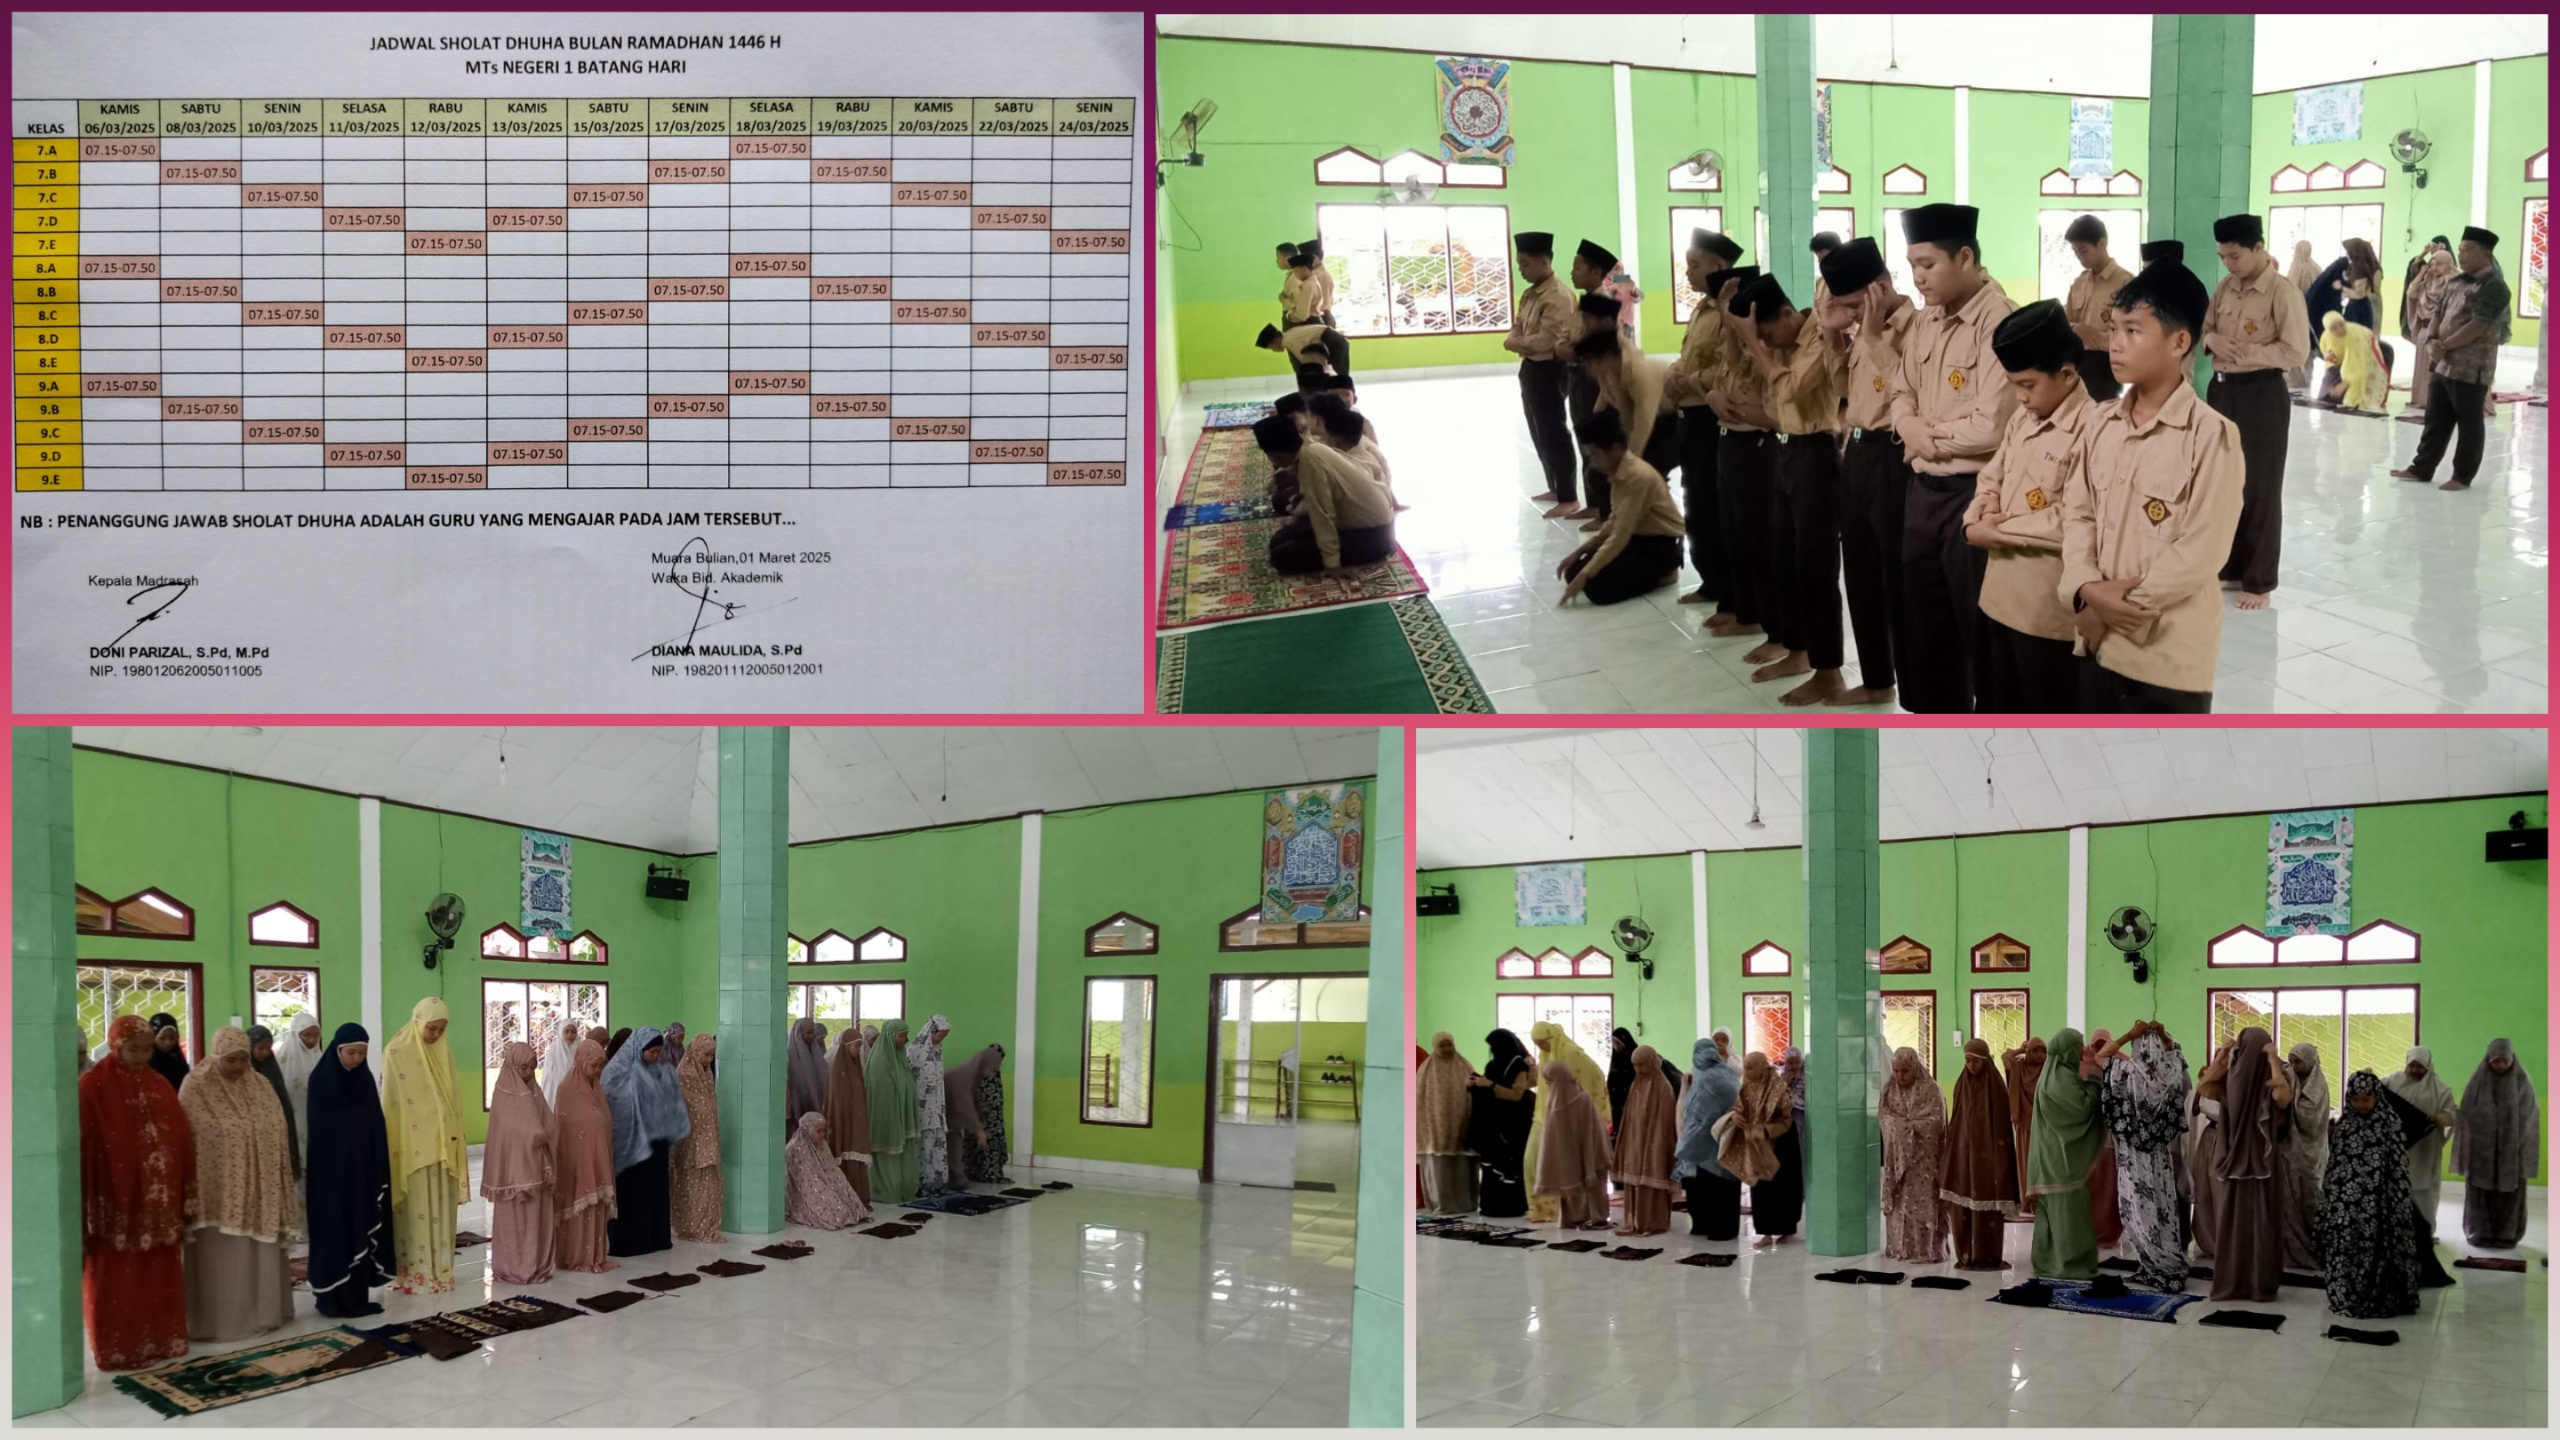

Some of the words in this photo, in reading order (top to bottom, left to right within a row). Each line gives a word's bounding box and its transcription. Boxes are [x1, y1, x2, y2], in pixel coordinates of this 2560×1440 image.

[369, 36, 436, 51] JADWAL
[439, 36, 502, 51] SHOLAT
[505, 36, 565, 51] DHUHA
[569, 36, 623, 51] BULAN
[627, 35, 724, 50] RAMADHAN
[728, 34, 766, 49] 1446
[770, 35, 781, 49] H
[465, 60, 499, 75] MTs
[503, 60, 560, 75] NEGERI
[564, 60, 573, 74] 1
[577, 60, 643, 74] BATANG
[648, 59, 686, 74] HARI
[99, 103, 141, 115] KAMIS
[181, 103, 221, 115] SABTU
[264, 103, 301, 114] SENIN
[342, 102, 387, 114] SELASA
[428, 102, 463, 114] RABU
[507, 102, 548, 114] KAMIS
[588, 102, 629, 114] SABTU
[671, 102, 709, 113] SENIN
[749, 101, 794, 113] SELASA
[836, 101, 870, 113] RABU
[914, 101, 954, 113] KAMIS
[994, 102, 1034, 113] SABTU
[1076, 102, 1113, 113] SENIN
[27, 123, 65, 135] KELAS
[84, 121, 156, 136] 06/03/2025
[165, 121, 237, 136] 08/03/2025
[247, 120, 318, 135] 10/03/2025
[329, 120, 400, 135] 11/03/2025
[410, 120, 482, 135] 12/03/2025
[492, 120, 563, 135] 13/03/2025
[573, 120, 644, 135] 15/03/2025
[655, 119, 726, 134] 17/03/2025
[736, 119, 807, 134] 18/03/2025
[817, 119, 889, 134] 19/03/2025
[897, 119, 969, 134] 20/03/2025
[979, 119, 1049, 134] 22/03/2025
[1059, 119, 1129, 134] 24/03/2025
[37, 145, 58, 156] 7.A
[85, 144, 156, 156] 07.15-07.50
[735, 142, 807, 154] 07.15-07.50
[37, 168, 57, 180] 7.B
[166, 167, 237, 179] 07.15-07.50
[654, 166, 726, 178] 07.15-07.50
[816, 165, 888, 178] 07.15-07.50
[38, 192, 58, 203] 7.C
[247, 190, 319, 203] 07.15-07.50
[573, 190, 644, 203] 07.15-07.50
[897, 189, 968, 201] 07.15-07.50
[37, 215, 58, 227] 7.D
[329, 214, 401, 226] 07.15-07.50
[492, 214, 563, 226] 07.15-07.50
[977, 213, 1047, 224] 07.15-07.50
[37, 239, 57, 250] 7.E
[410, 238, 483, 250] 07.15-07.50
[1056, 236, 1126, 248] 07.15-07.50
[36, 263, 57, 274] 8.A
[84, 262, 156, 274] 07.15-07.50
[735, 260, 807, 272] 07.15-07.50
[36, 286, 57, 298] 8.B
[166, 285, 238, 297] 07.15-07.50
[653, 284, 725, 296] 07.15-07.50
[816, 283, 887, 295] 07.15-07.50
[38, 310, 57, 321] 8.C
[248, 308, 320, 320] 07.15-07.50
[573, 308, 644, 320] 07.15-07.50
[897, 306, 967, 318] 07.15-07.50
[38, 333, 59, 345] 8.D
[329, 332, 402, 344] 07.15-07.50
[492, 331, 563, 343] 07.15-07.50
[976, 330, 1046, 342] 07.15-07.50
[39, 357, 58, 369] 8.E
[411, 355, 483, 367] 07.15-07.50
[1055, 353, 1124, 365] 07.15-07.50
[38, 380, 60, 392] 9.A
[86, 380, 157, 392] 07.15-07.50
[734, 377, 806, 389] 07.15-07.50
[40, 404, 60, 415] 9.B
[167, 403, 239, 415] 07.15-07.50
[653, 401, 725, 413] 07.15-07.50
[816, 401, 887, 413] 07.15-07.50
[40, 427, 60, 439] 9.C
[248, 426, 320, 438] 07.15-07.50
[573, 424, 644, 436] 07.15-07.50
[896, 424, 966, 436] 07.15-07.50
[40, 451, 62, 462] 9.D
[330, 449, 402, 462] 07.15-07.50
[492, 448, 563, 460] 07.15-07.50
[975, 446, 1045, 458] 07.15-07.50
[41, 474, 61, 486] 9.E
[411, 472, 483, 484] 07.15-07.50
[1053, 468, 1122, 480] 07.15-07.50
[20, 515, 44, 529] NB
[48, 518, 53, 529] :
[57, 514, 169, 528] PENANGGUNG
[172, 514, 229, 528] JAWAB
[232, 514, 294, 529] SHOLAT
[297, 514, 356, 528] DHUHA
[359, 513, 425, 528] ADALAH
[428, 513, 475, 528] GURU
[479, 512, 524, 527] YANG
[528, 512, 615, 527] MENGAJAR
[619, 512, 663, 526] PADA
[666, 512, 700, 526] JAM
[703, 512, 796, 526] TERSEBUT...
[651, 551, 692, 565] Muara
[695, 551, 755, 566] Bulian,01
[759, 551, 796, 564] Maret
[799, 551, 832, 564] 2025
[88, 574, 133, 589] Kepala
[136, 574, 200, 588] Madrasah
[651, 572, 689, 584] Waka
[692, 572, 717, 584] Bid.
[720, 571, 784, 584] Akademik
[89, 647, 126, 660] DONI
[129, 646, 192, 660] PARIZAL,
[196, 646, 232, 660] S.Pd,
[235, 646, 270, 659] M.Pd
[651, 645, 696, 657] DIANA
[699, 644, 766, 658] MAULIDA,
[771, 644, 803, 656] S.Pd
[90, 665, 117, 677] NIP.
[122, 664, 263, 677] 198012062005011005
[651, 664, 678, 677] NIP.
[684, 663, 823, 677] 198201112005012001
